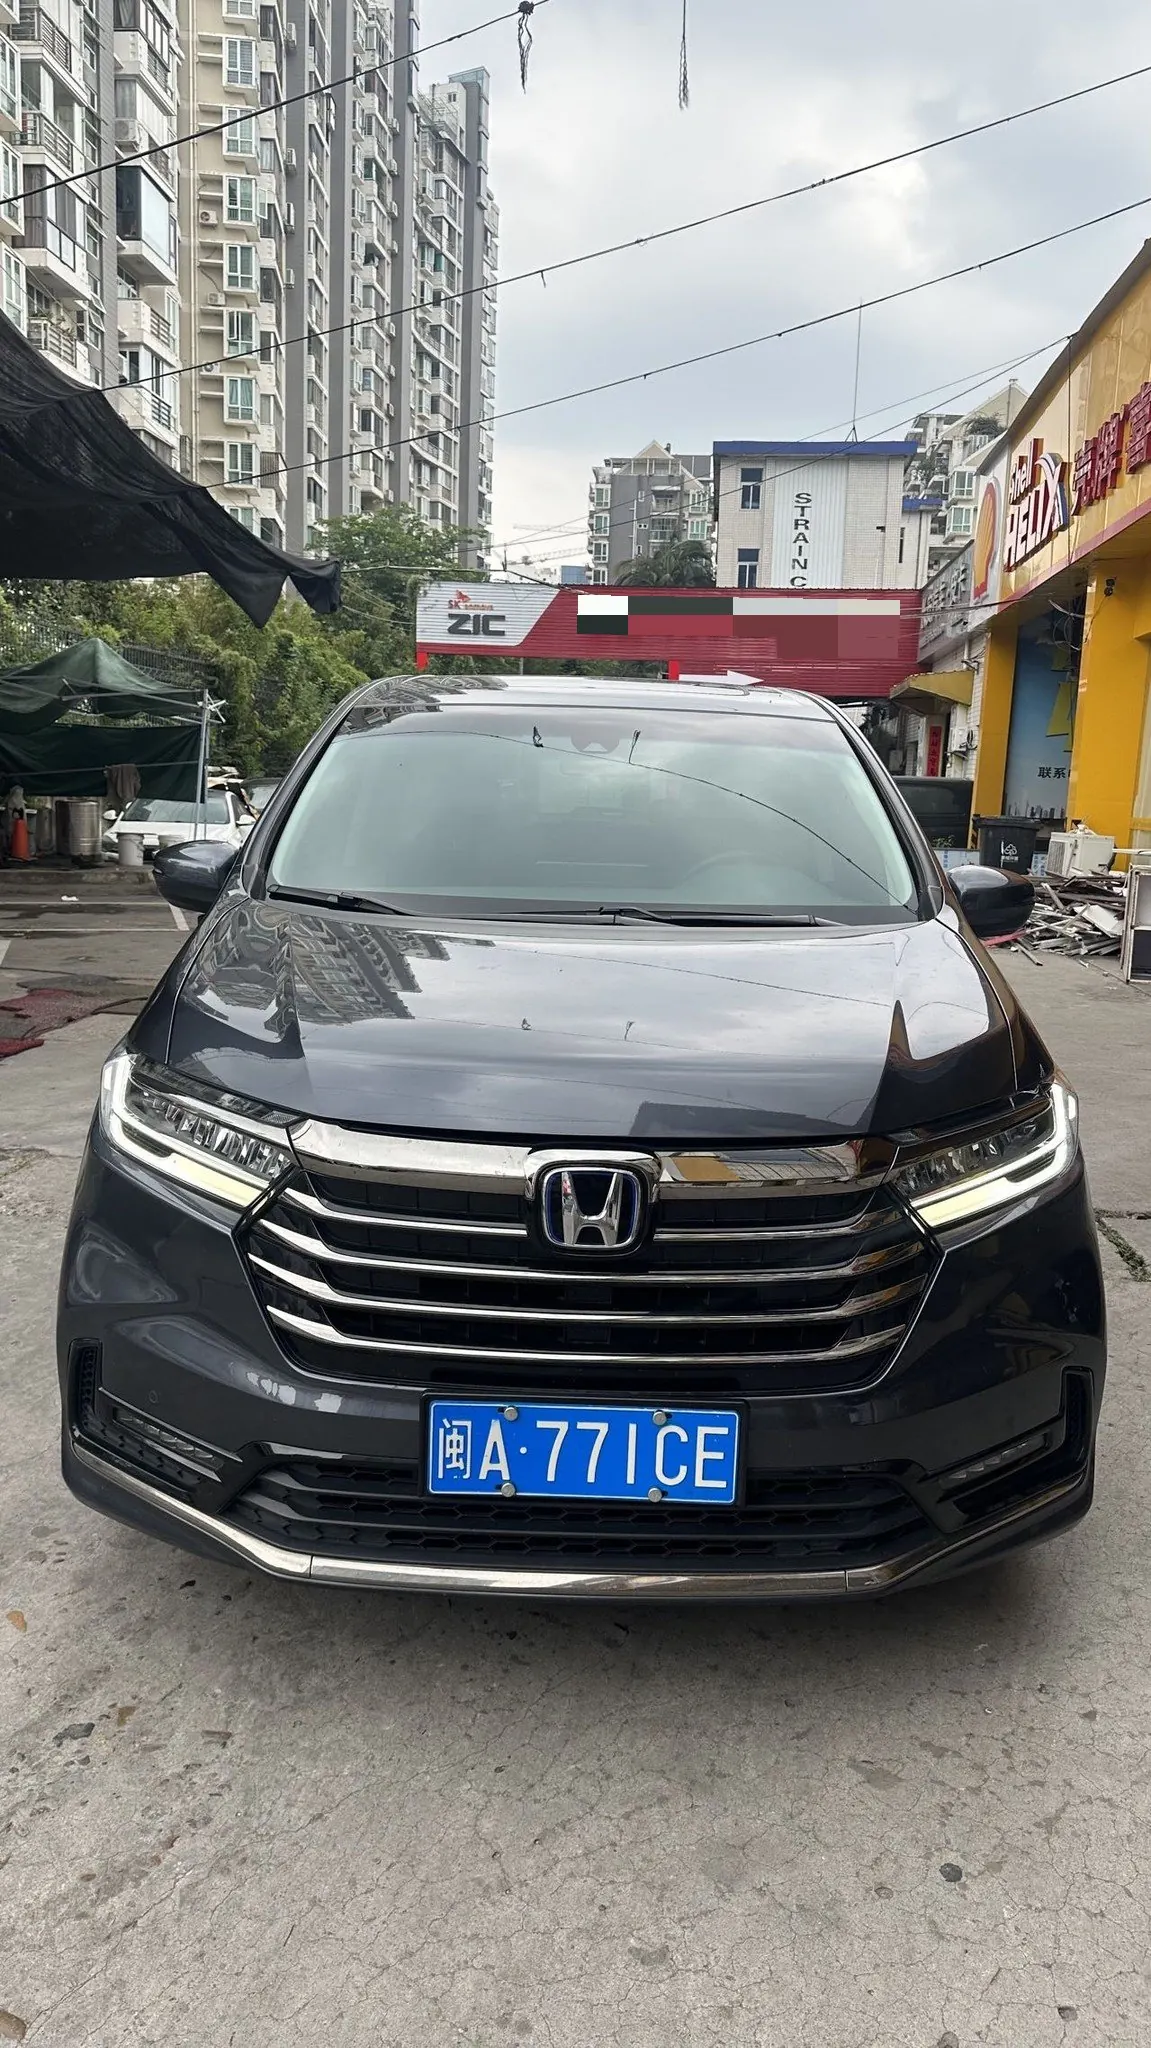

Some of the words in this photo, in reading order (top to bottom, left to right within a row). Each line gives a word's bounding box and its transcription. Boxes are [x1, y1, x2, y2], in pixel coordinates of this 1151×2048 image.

[1009, 438, 1041, 504] Shell
[1004, 453, 1069, 571] HELIX
[448, 600, 460, 609] SK
[447, 613, 506, 636] ZIC
[1037, 766, 1071, 779] 联系
